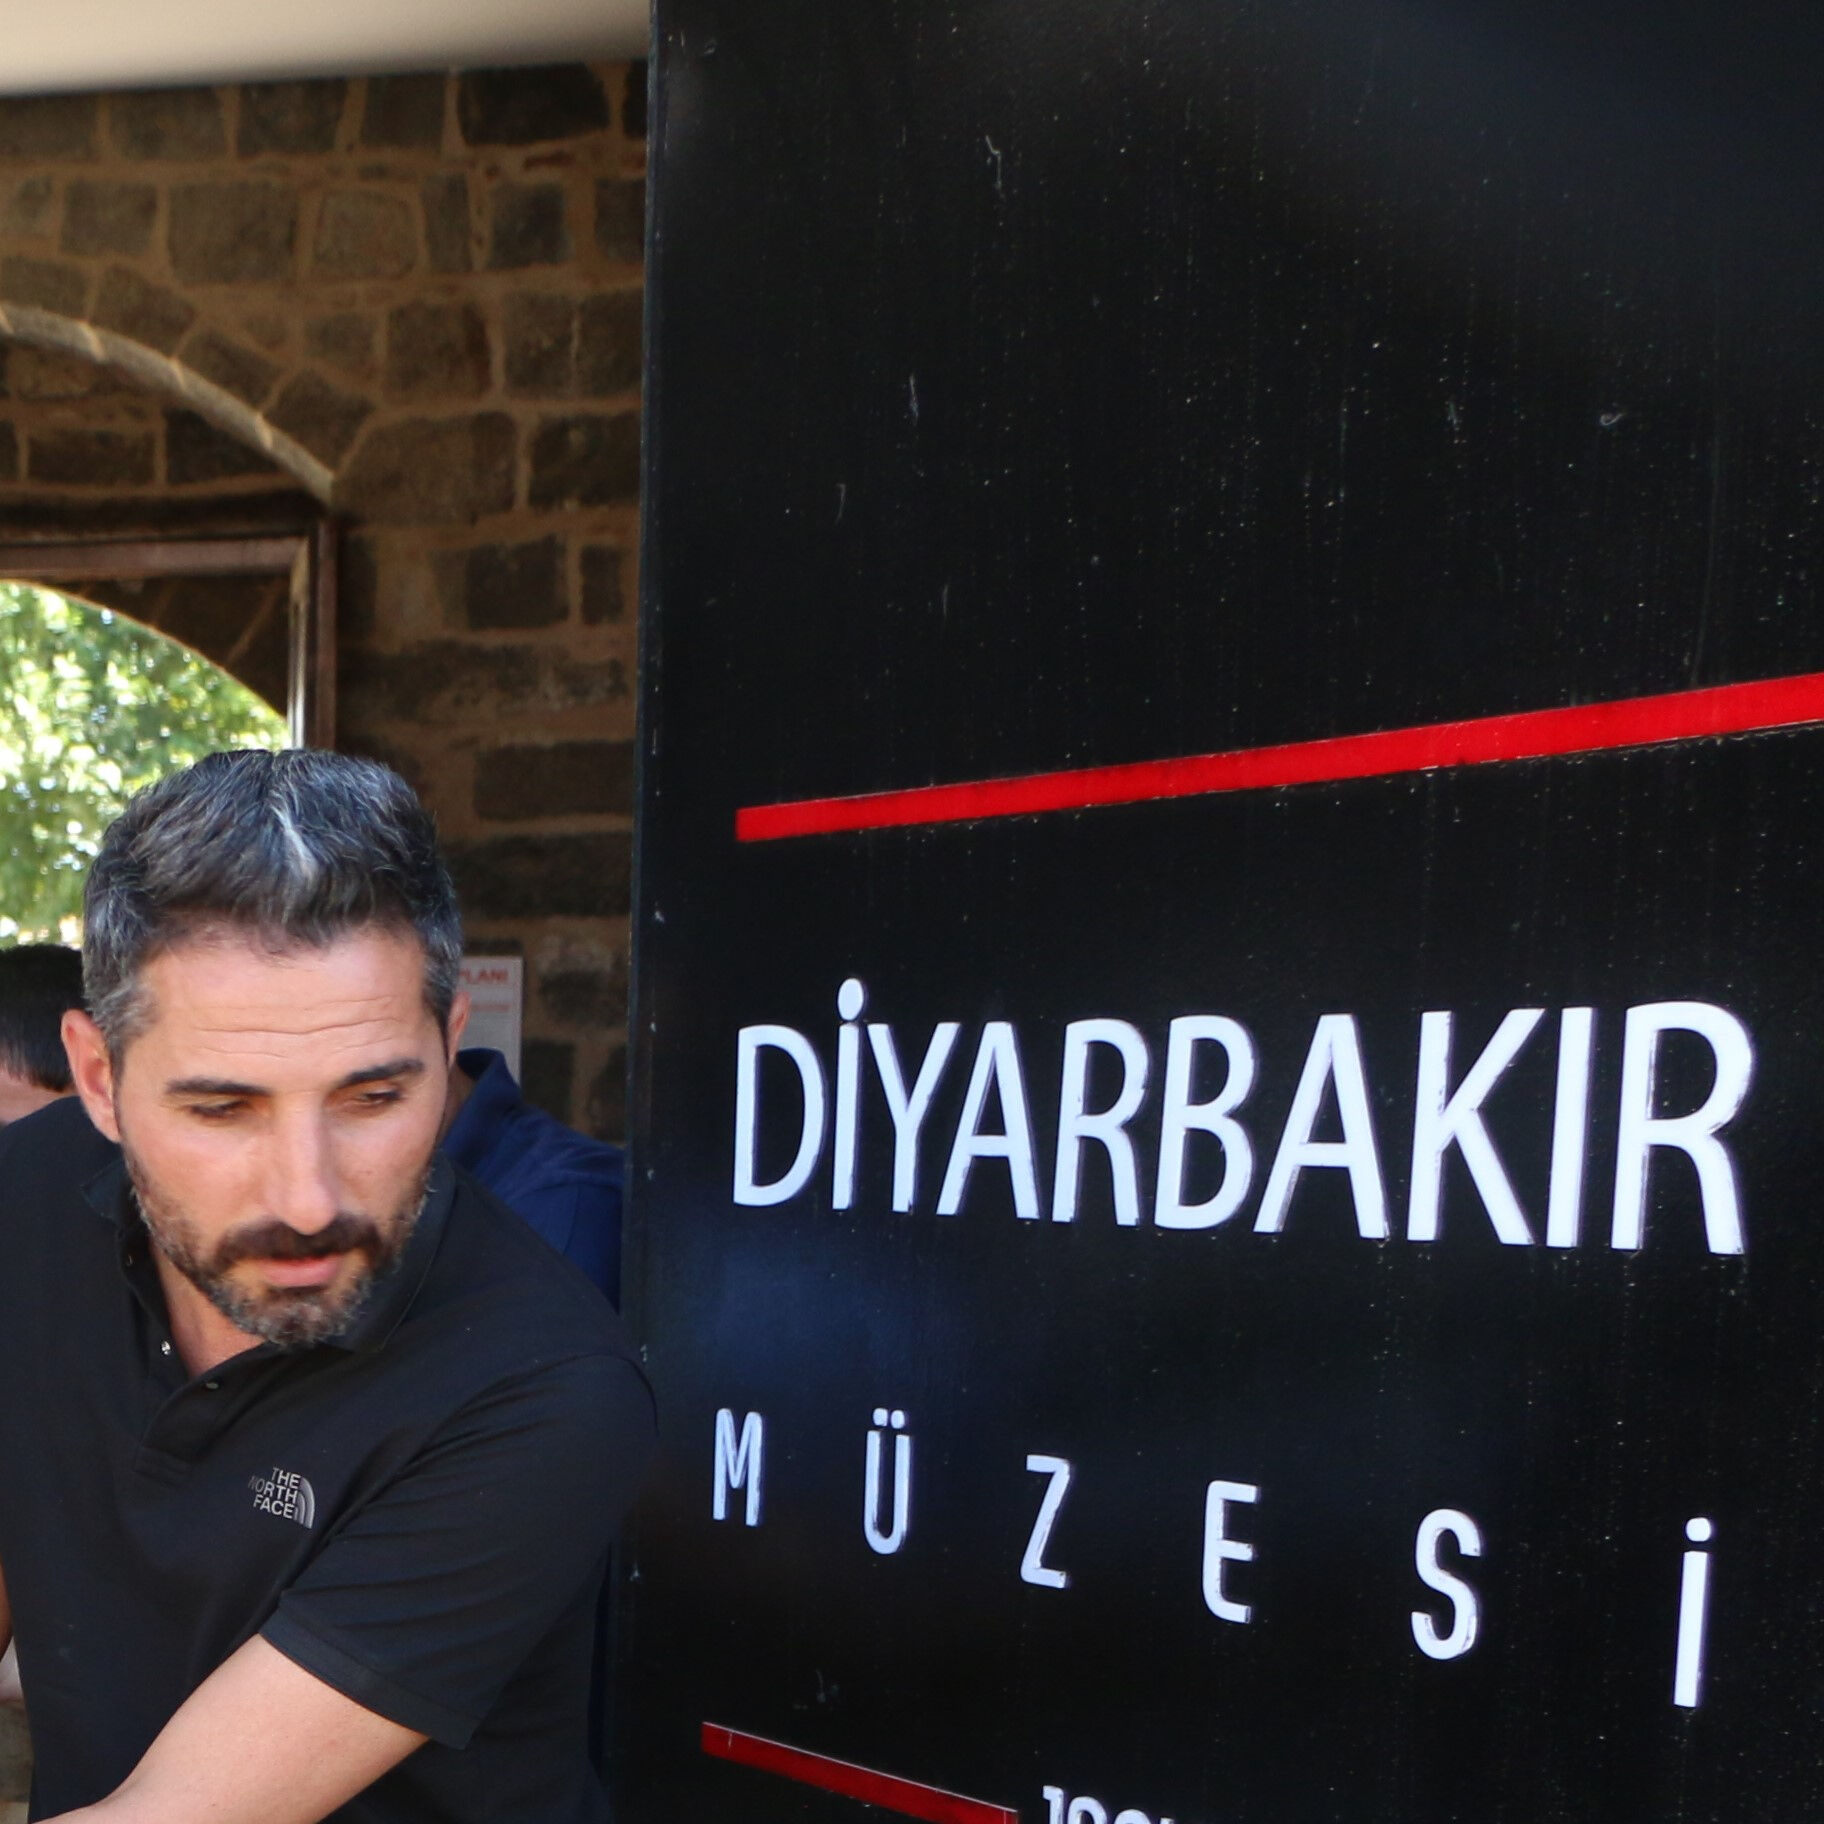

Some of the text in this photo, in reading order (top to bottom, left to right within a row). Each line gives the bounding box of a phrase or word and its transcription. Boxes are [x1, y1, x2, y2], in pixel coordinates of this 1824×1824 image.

[732, 977, 1756, 1256] DİYARBAKIR
[248, 1475, 298, 1504] NORTH
[272, 1467, 301, 1489] THE
[253, 1494, 295, 1519] FACE
